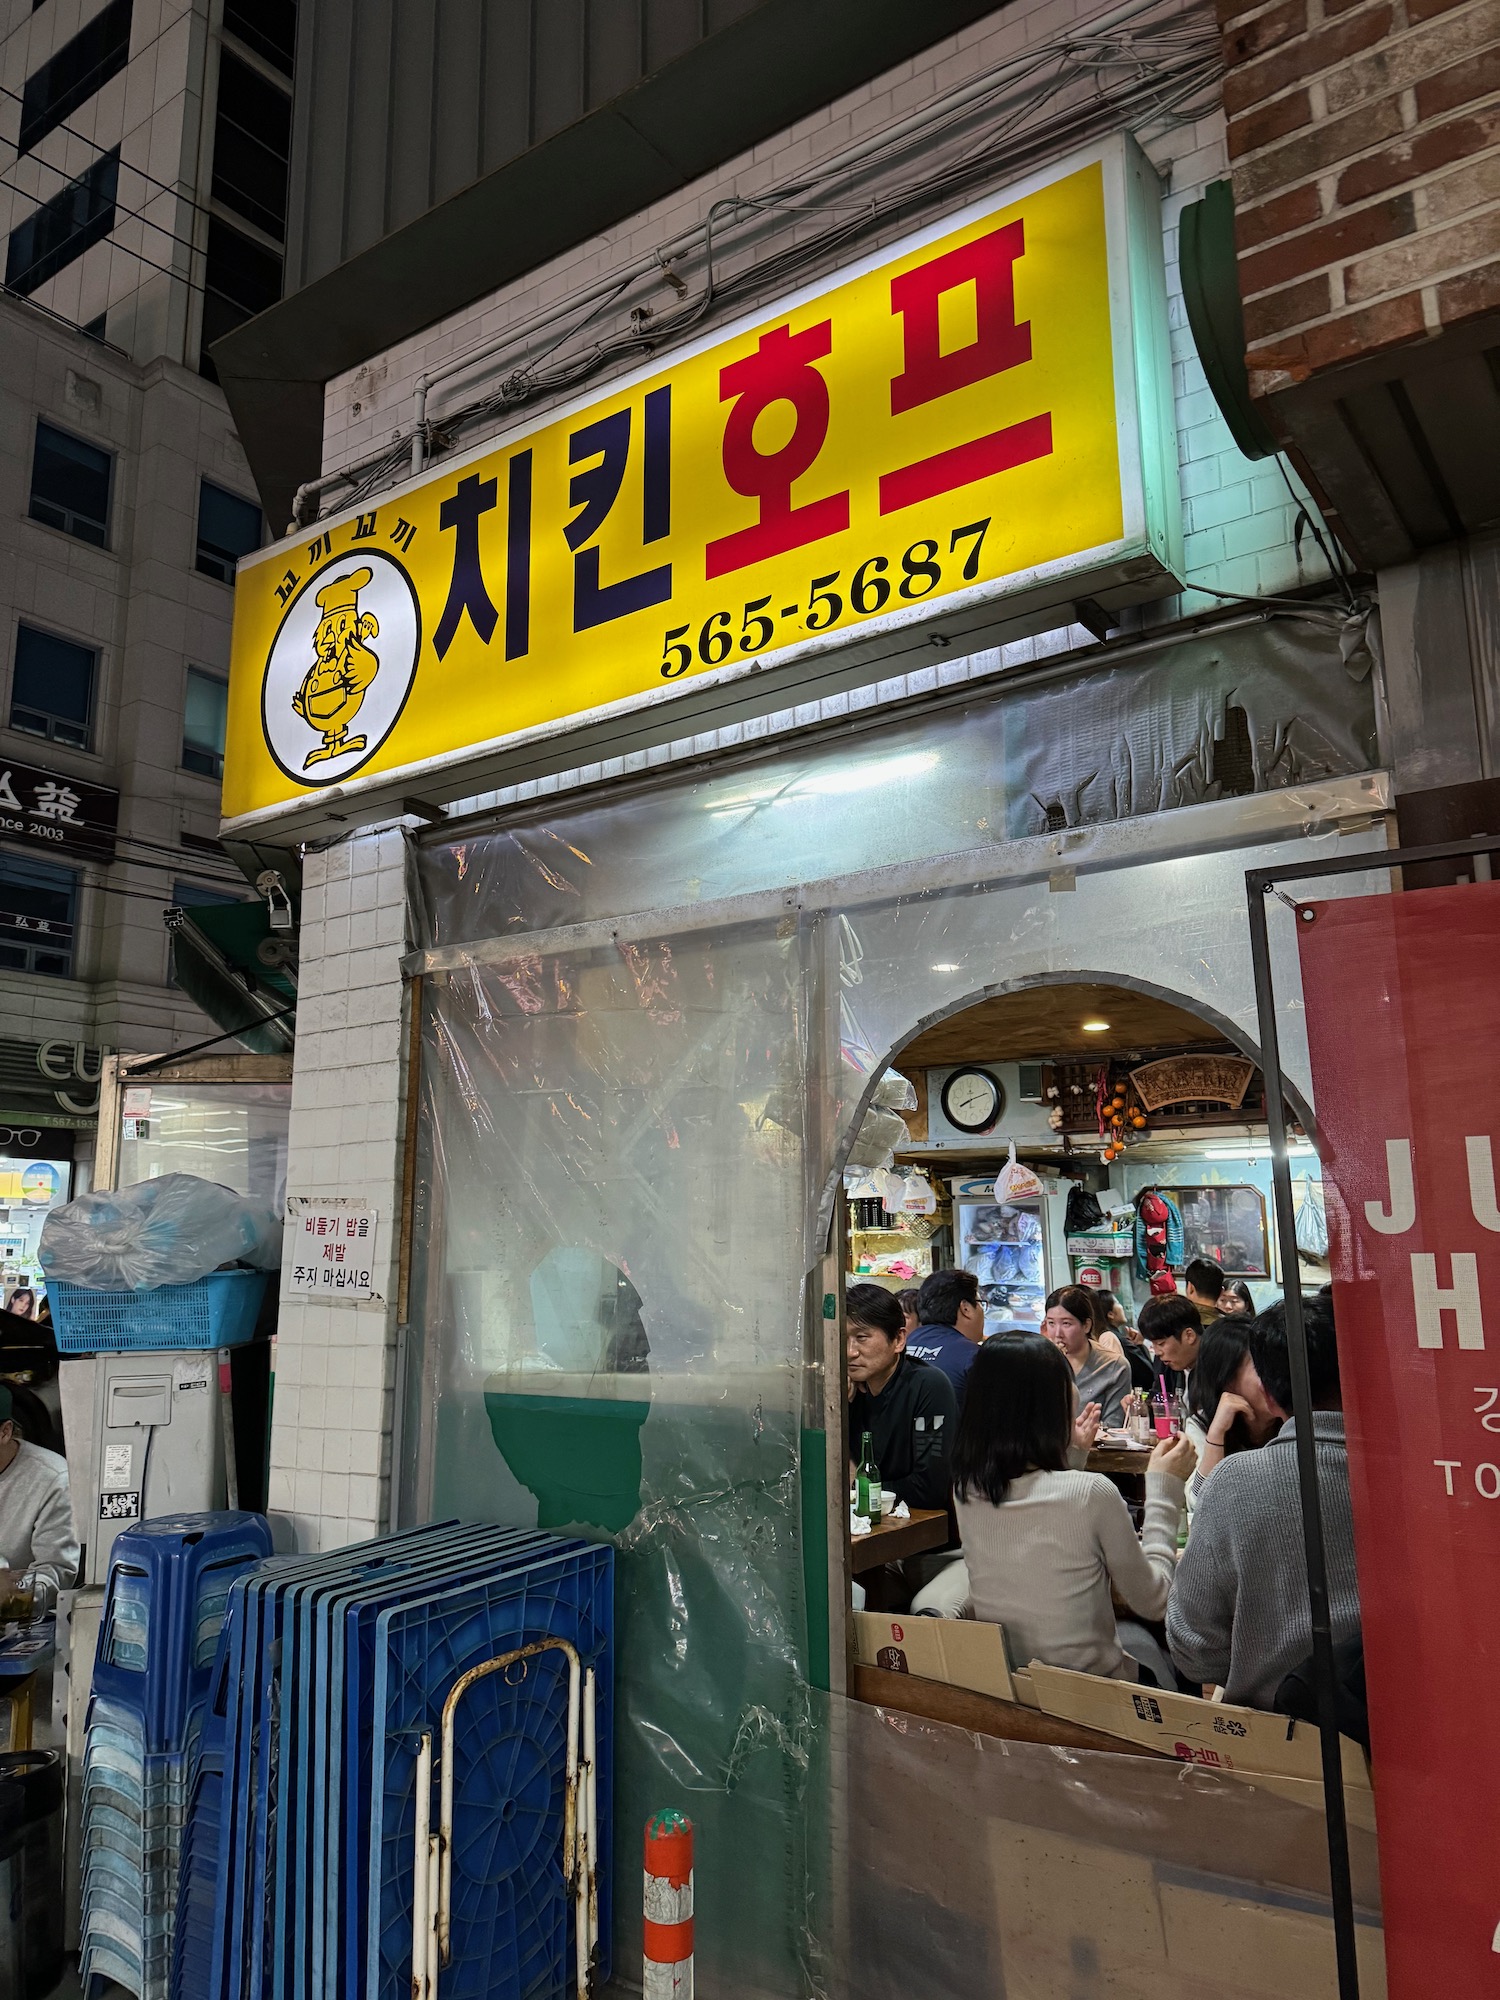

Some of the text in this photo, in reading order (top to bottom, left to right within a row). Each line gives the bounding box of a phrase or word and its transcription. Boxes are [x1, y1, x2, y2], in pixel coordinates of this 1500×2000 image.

[659, 516, 993, 679] 565-5687
[29, 822, 64, 841] 2003
[305, 1216, 369, 1237] 비둘기 밥을
[322, 1243, 346, 1262] 제발
[293, 1266, 370, 1288] 주지 마십시요
